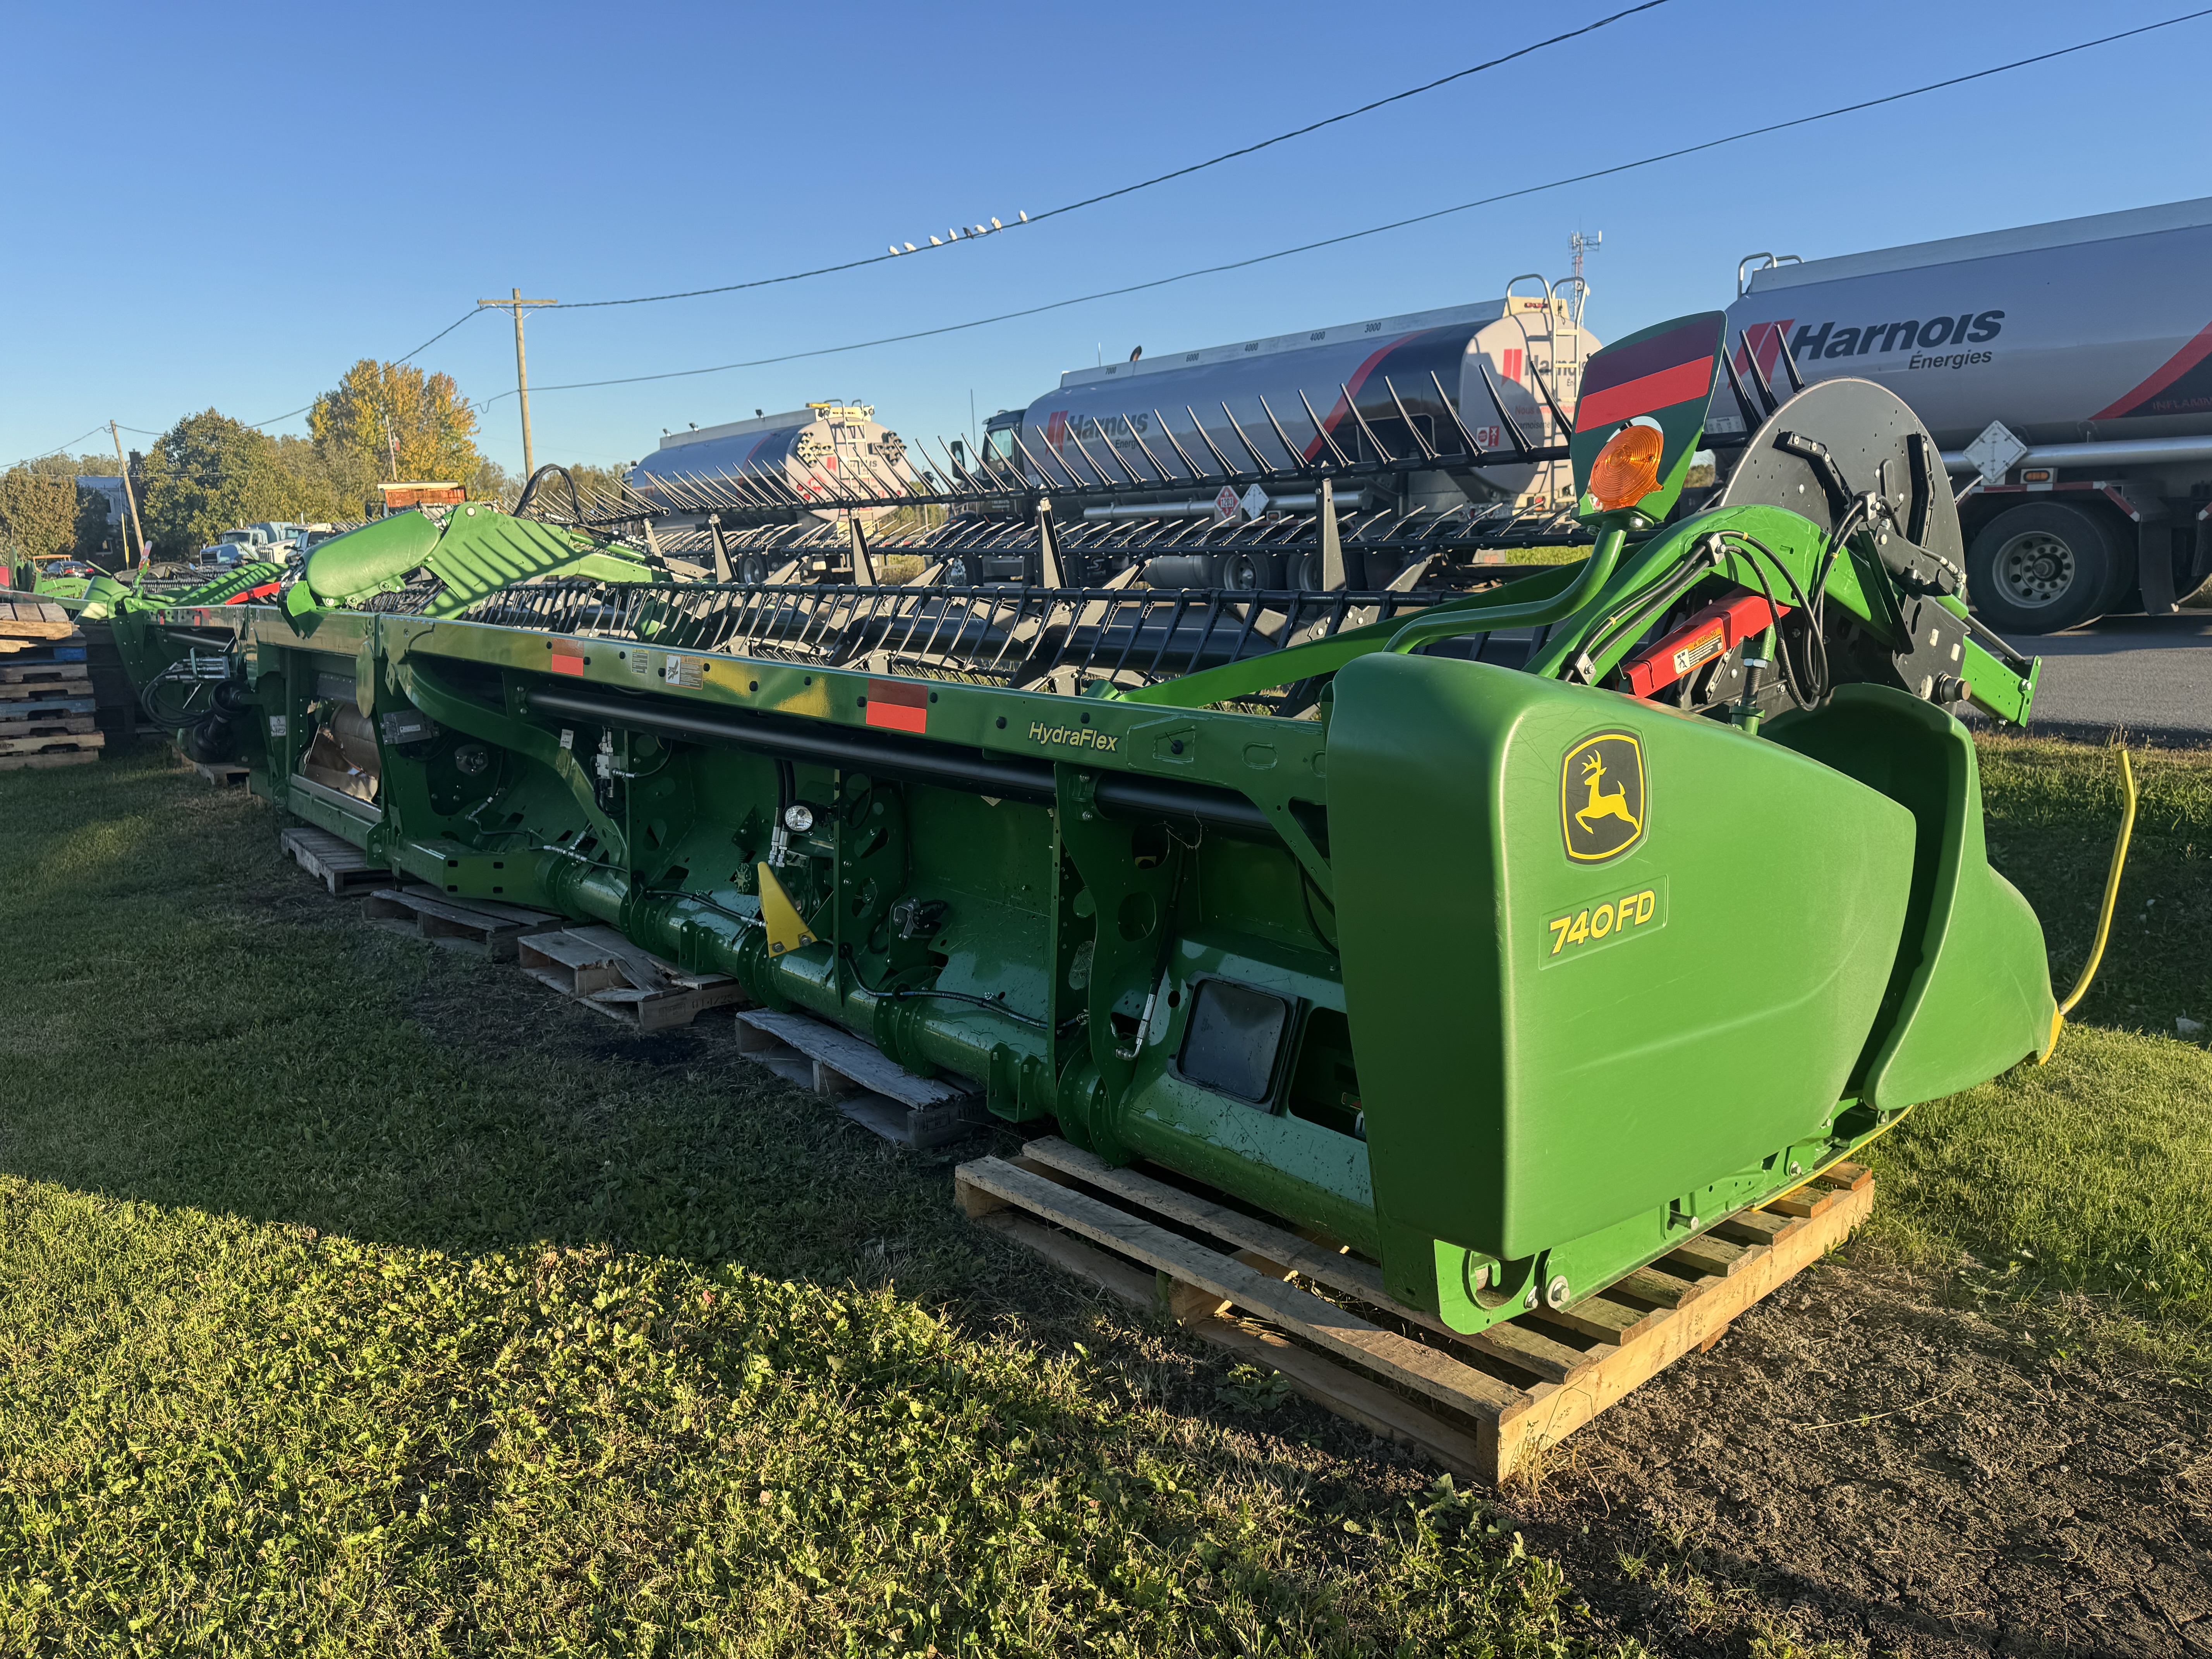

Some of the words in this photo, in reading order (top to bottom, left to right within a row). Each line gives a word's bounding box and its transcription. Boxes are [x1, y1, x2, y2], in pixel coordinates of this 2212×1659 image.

[1364, 322, 1381, 333] 3000
[1310, 331, 1326, 342] 4000
[1792, 310, 2005, 362] Harnois
[1244, 342, 1259, 352] 4000
[1186, 353, 1200, 362] 6000
[1908, 349, 1992, 370] Énergies
[1029, 721, 1118, 751] HydraFlex
[1549, 890, 1656, 955] 740FD
